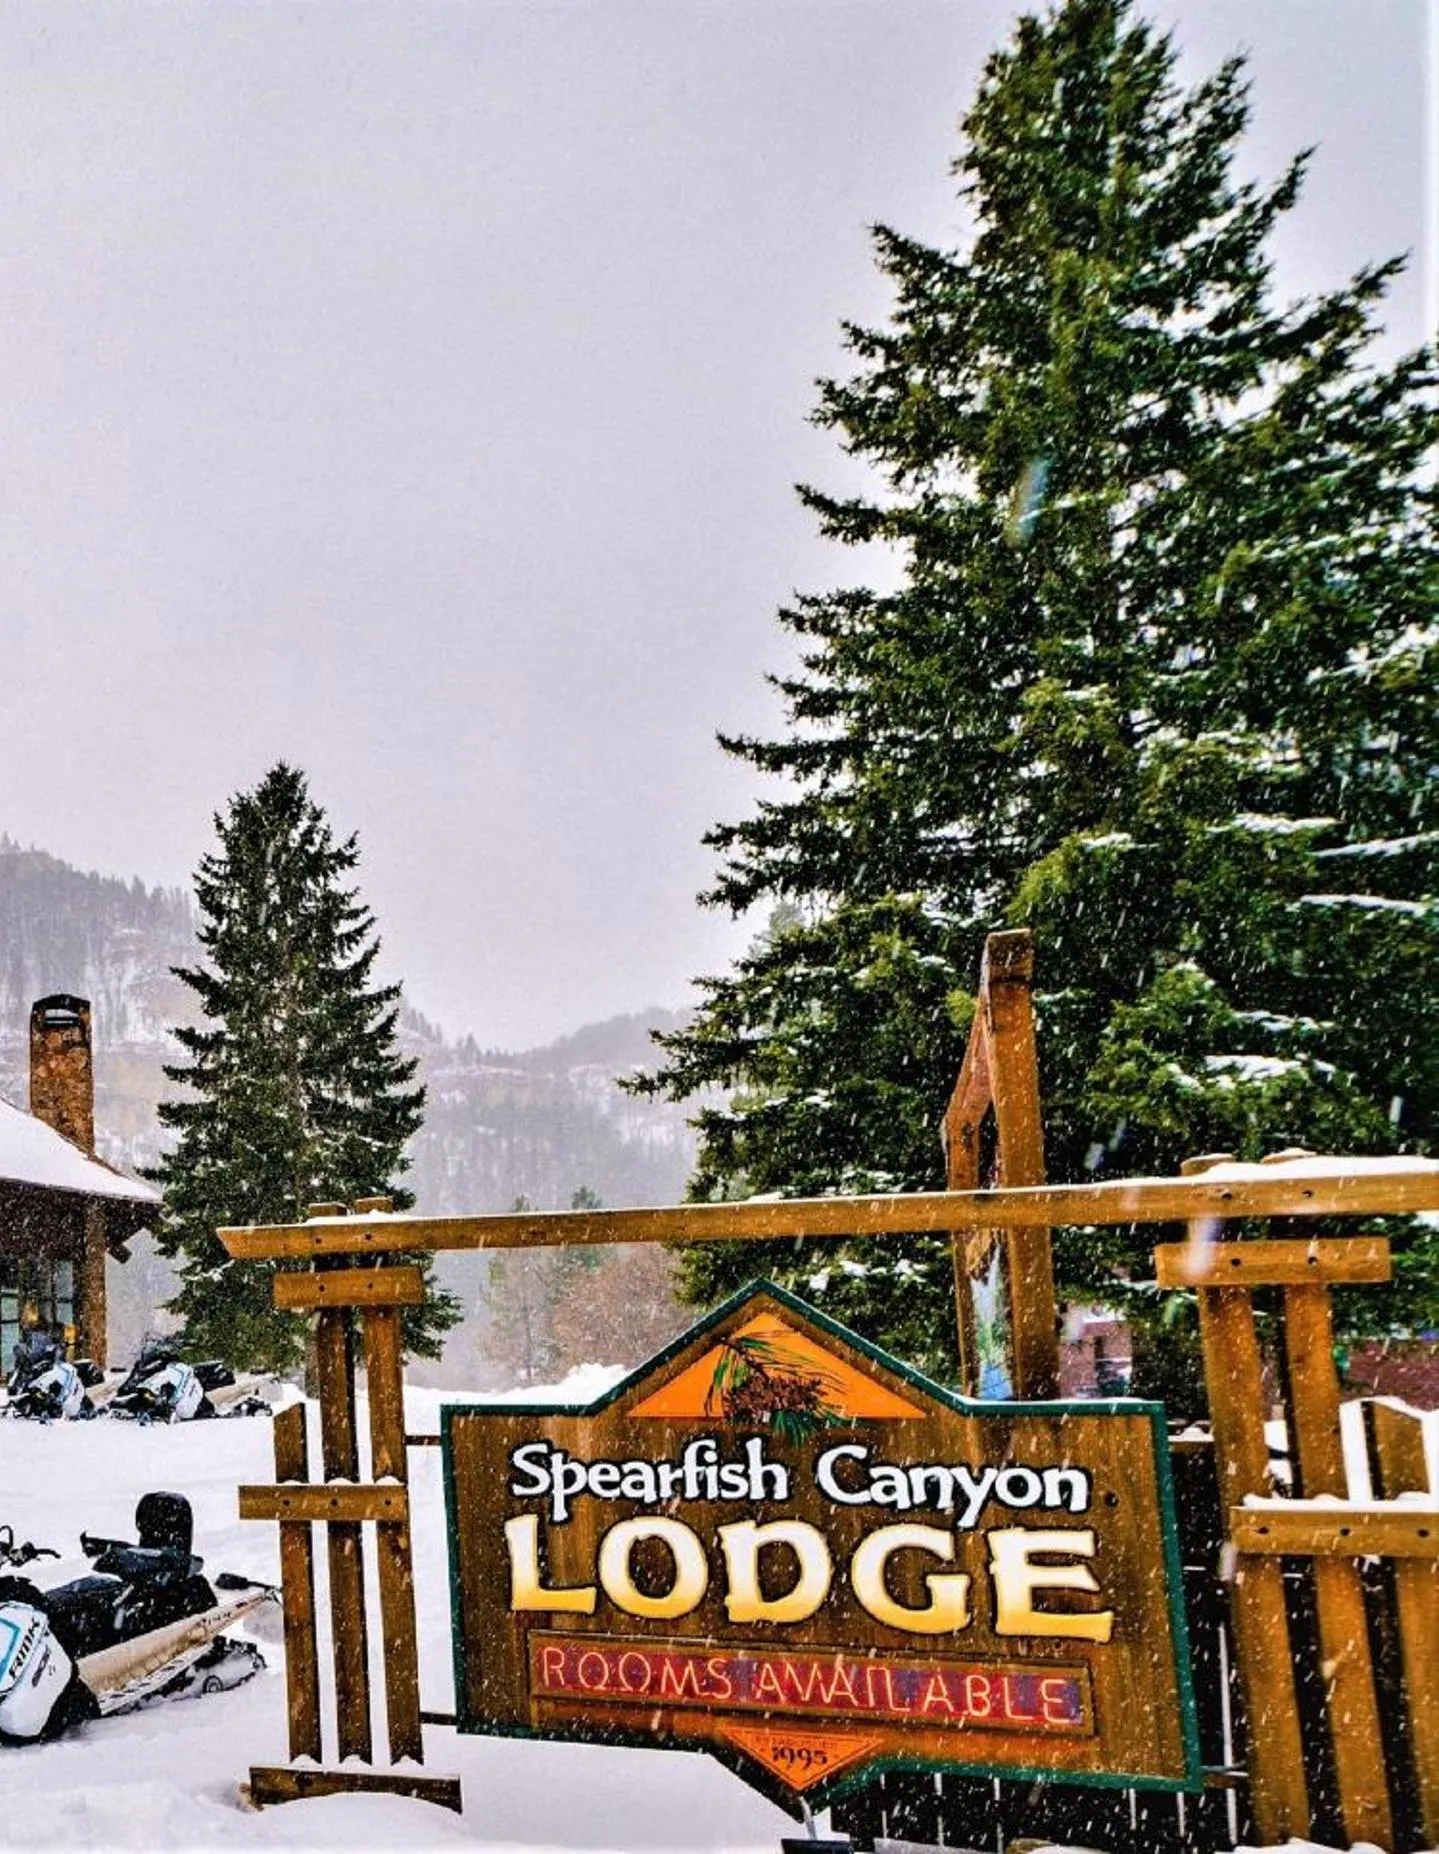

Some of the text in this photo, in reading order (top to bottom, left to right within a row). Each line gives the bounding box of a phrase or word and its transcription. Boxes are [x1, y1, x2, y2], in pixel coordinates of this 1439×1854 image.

[511, 1436, 1088, 1528] Spearfish Canyon
[504, 1513, 1115, 1643] LODGE
[9, 1617, 40, 1679] RMK
[543, 1646, 1071, 1723] ROOMS AVAILABLE
[771, 1745, 828, 1770] 1995
